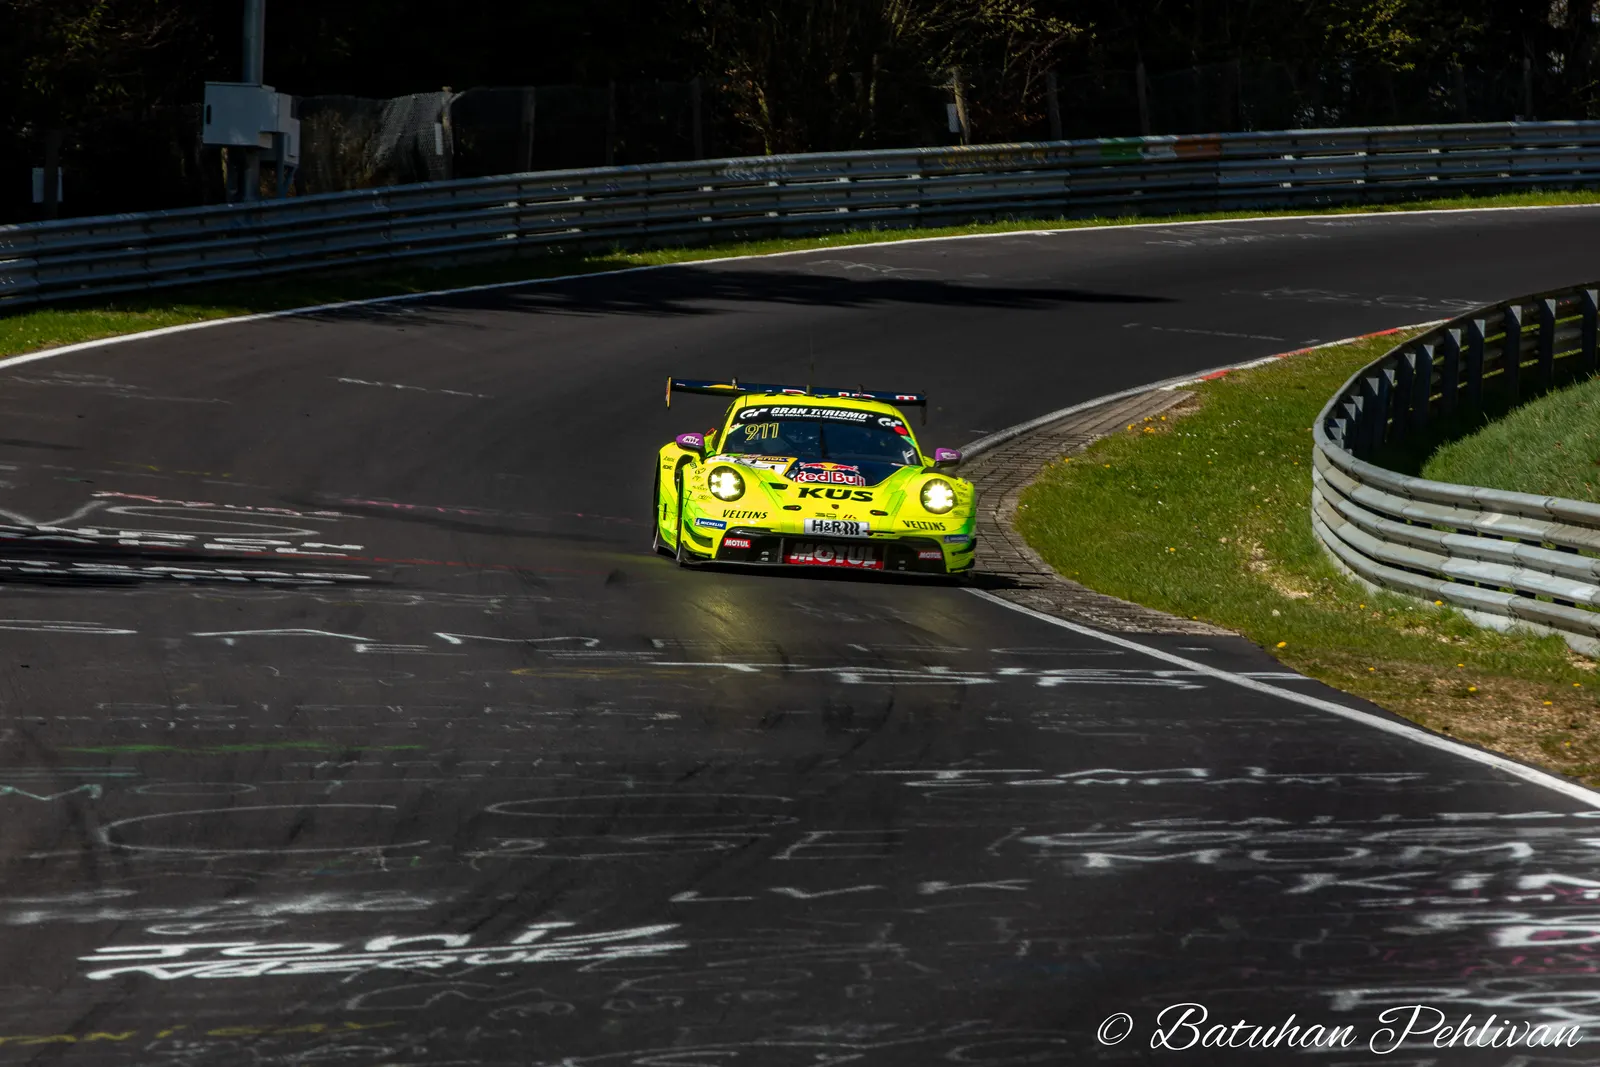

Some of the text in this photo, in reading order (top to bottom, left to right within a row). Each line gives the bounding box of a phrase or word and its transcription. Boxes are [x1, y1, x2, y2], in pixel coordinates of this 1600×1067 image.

[770, 407, 806, 415] GRAN
[745, 423, 779, 441] 911
[793, 471, 866, 487] Red Bull
[798, 487, 873, 502] KÜS
[722, 509, 768, 519] VELTINS
[700, 520, 724, 528] MICHELIN
[812, 519, 843, 534] H&R
[903, 520, 946, 531] VELTINS
[724, 539, 749, 548] MOTUL
[789, 542, 878, 566] MOTUL
